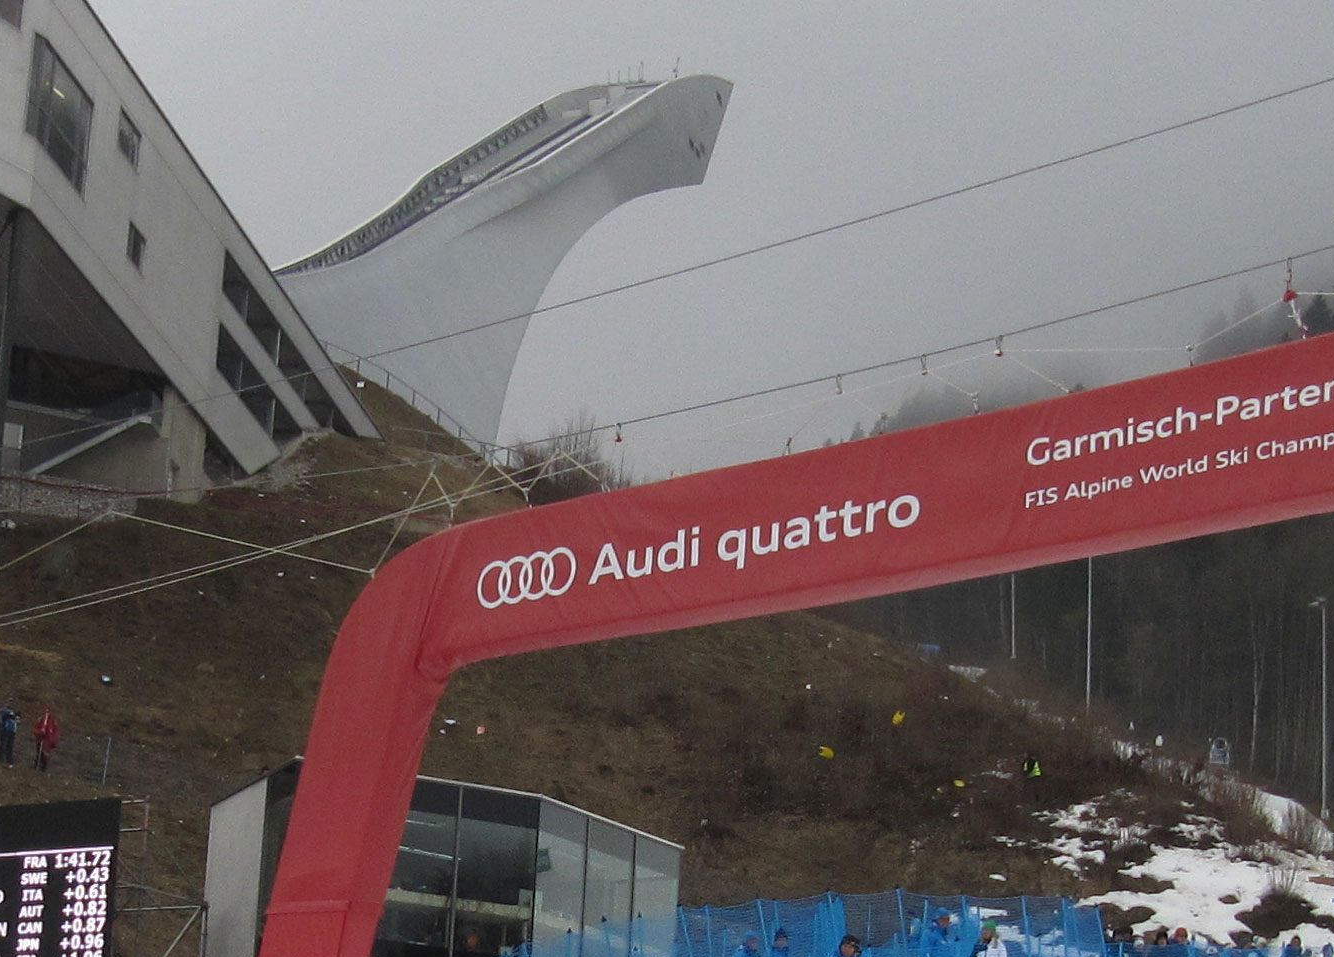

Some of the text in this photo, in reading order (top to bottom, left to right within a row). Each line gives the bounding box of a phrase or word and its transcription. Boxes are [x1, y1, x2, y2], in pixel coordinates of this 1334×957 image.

[1025, 487, 1058, 509] FIS
[1065, 473, 1134, 501] Alpine
[1139, 455, 1209, 485] World
[1215, 446, 1249, 471] Ski
[588, 494, 921, 585] Audi quattro
[23, 856, 48, 869] FRA
[55, 850, 111, 868] 1:41.72
[20, 872, 48, 885] SWE
[65, 867, 109, 883] +0.43
[22, 889, 44, 902] ITA
[63, 884, 107, 900] +0.61
[19, 905, 44, 918] AUT
[62, 900, 107, 916] +0.82
[17, 921, 43, 934] CAN
[61, 917, 106, 933] +0.87
[16, 938, 40, 951] JPN
[59, 933, 104, 950] +0.96
